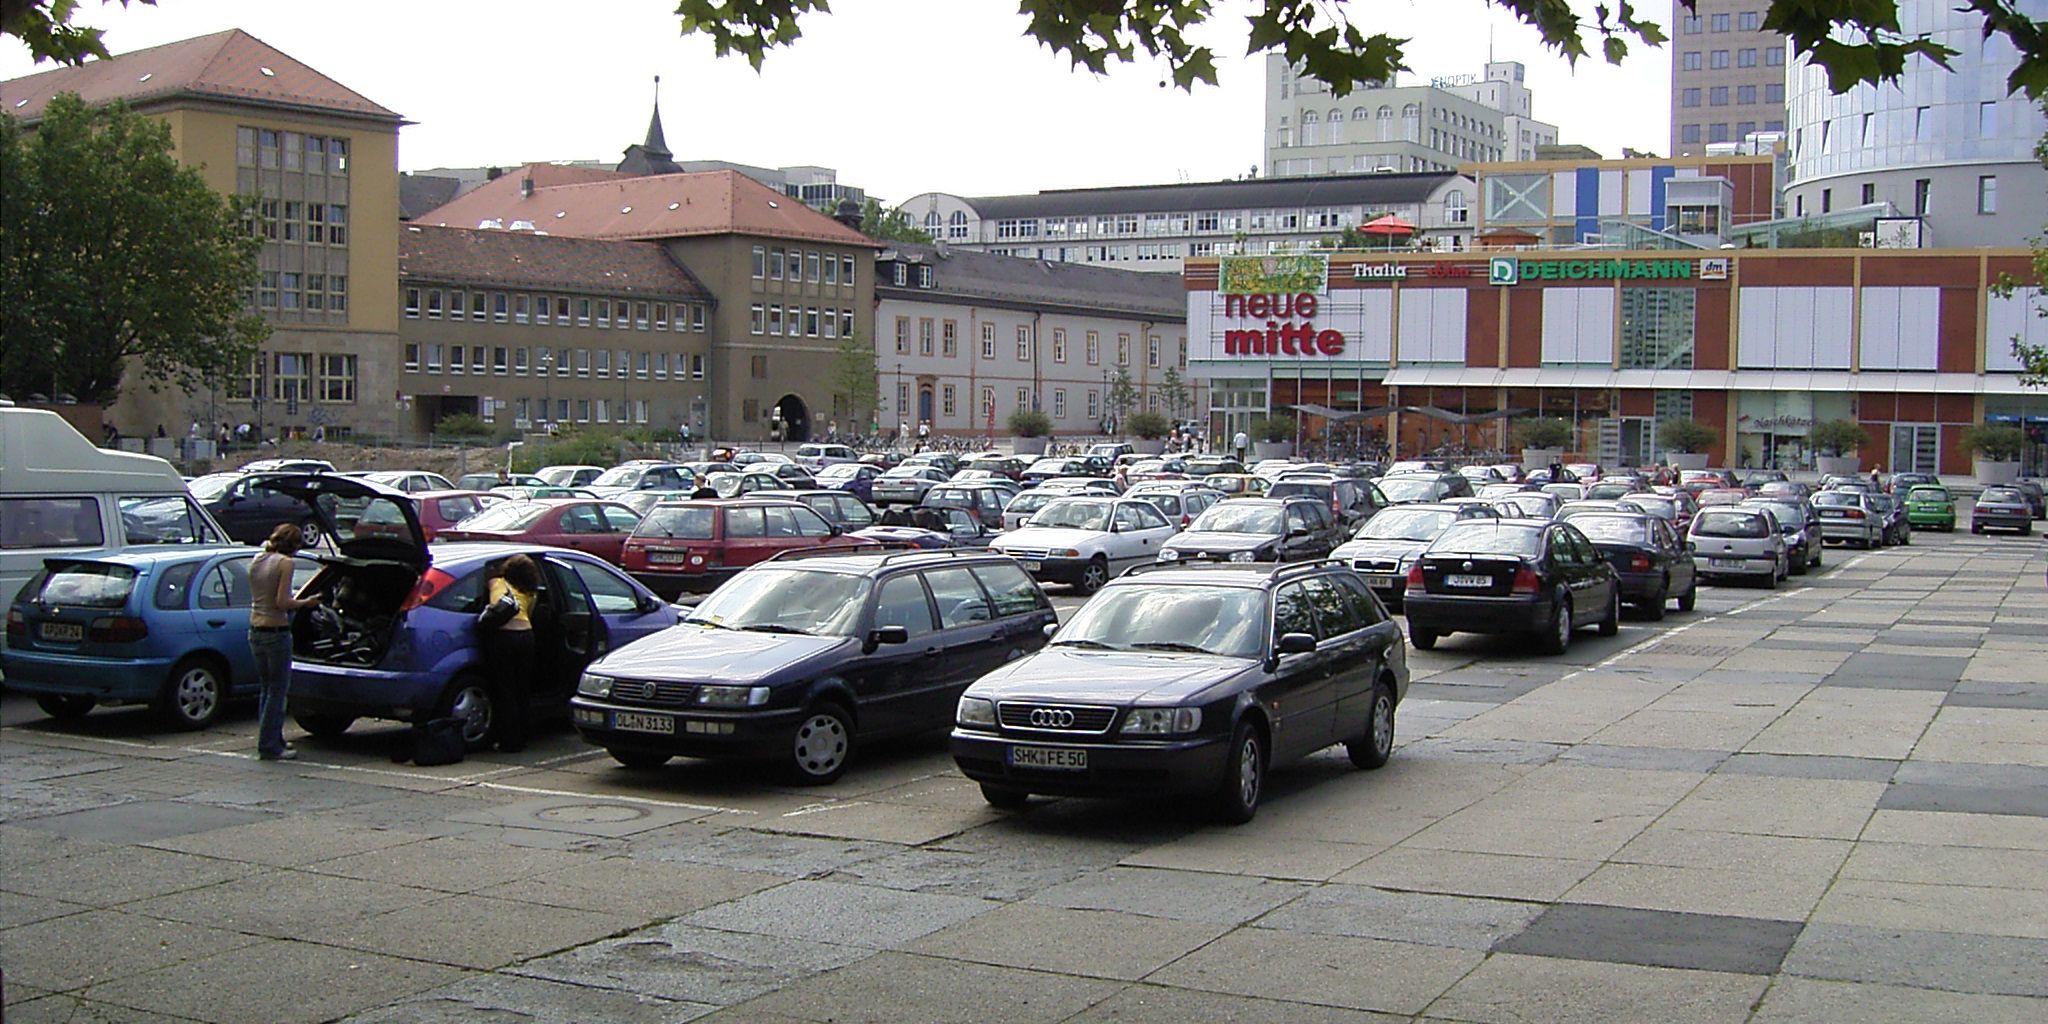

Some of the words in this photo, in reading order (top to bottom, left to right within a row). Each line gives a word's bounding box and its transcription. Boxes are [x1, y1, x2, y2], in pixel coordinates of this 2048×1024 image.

[1352, 263, 1407, 278] Thalia
[1521, 261, 1690, 279] DEICHMANN
[1706, 262, 1723, 273] dm
[1225, 292, 1318, 318] neue
[1225, 321, 1345, 355] mitte
[645, 716, 673, 732] 3133
[1014, 748, 1038, 764] SHK
[1048, 750, 1065, 765] FE
[1068, 751, 1085, 766] 50
